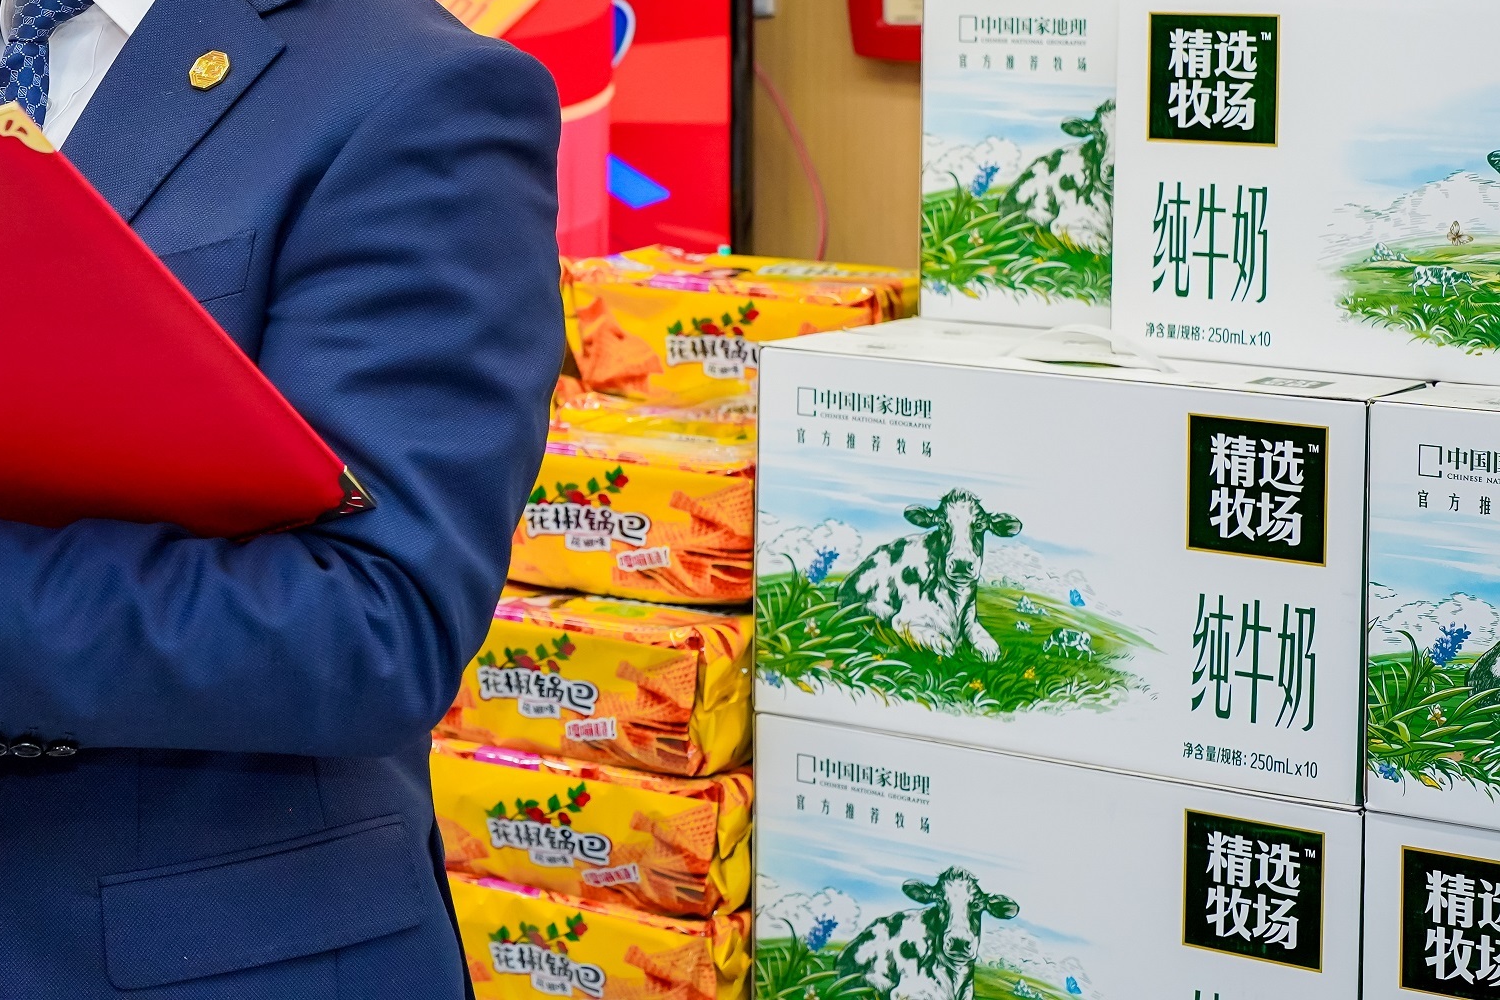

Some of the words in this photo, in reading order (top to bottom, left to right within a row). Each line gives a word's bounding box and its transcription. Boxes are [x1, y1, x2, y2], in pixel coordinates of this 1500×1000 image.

[981, 15, 1087, 37] 中国国家地理
[958, 53, 1088, 73] 官方推荐牧场
[1167, 27, 1258, 80] 精选
[1167, 78, 1257, 131] 牧场
[1152, 180, 1269, 304] 纯牛奶
[668, 336, 759, 363] 花椒锅
[820, 389, 932, 420] 中国国家地理
[820, 411, 850, 421] CHINESE
[851, 415, 887, 426] NATIONAL
[797, 427, 933, 458] 官方推荐牧场
[1447, 446, 1500, 474] 中国
[1209, 431, 1304, 493] 精选
[1446, 472, 1483, 483] CHINESE
[1208, 486, 1302, 547] 牧场
[1417, 489, 1492, 516] 官方推
[526, 506, 647, 541] 花椒锅巴
[1190, 592, 1318, 733] 纯牛奶
[480, 670, 594, 710] 花椒锅巴
[819, 757, 931, 796] 中国国家地理
[819, 779, 848, 791] CHINESE
[850, 786, 885, 798] NATIONAL
[796, 794, 931, 835] 官方推荐牧场
[1205, 830, 1301, 897] 精选
[1205, 885, 1300, 950] 牧场
